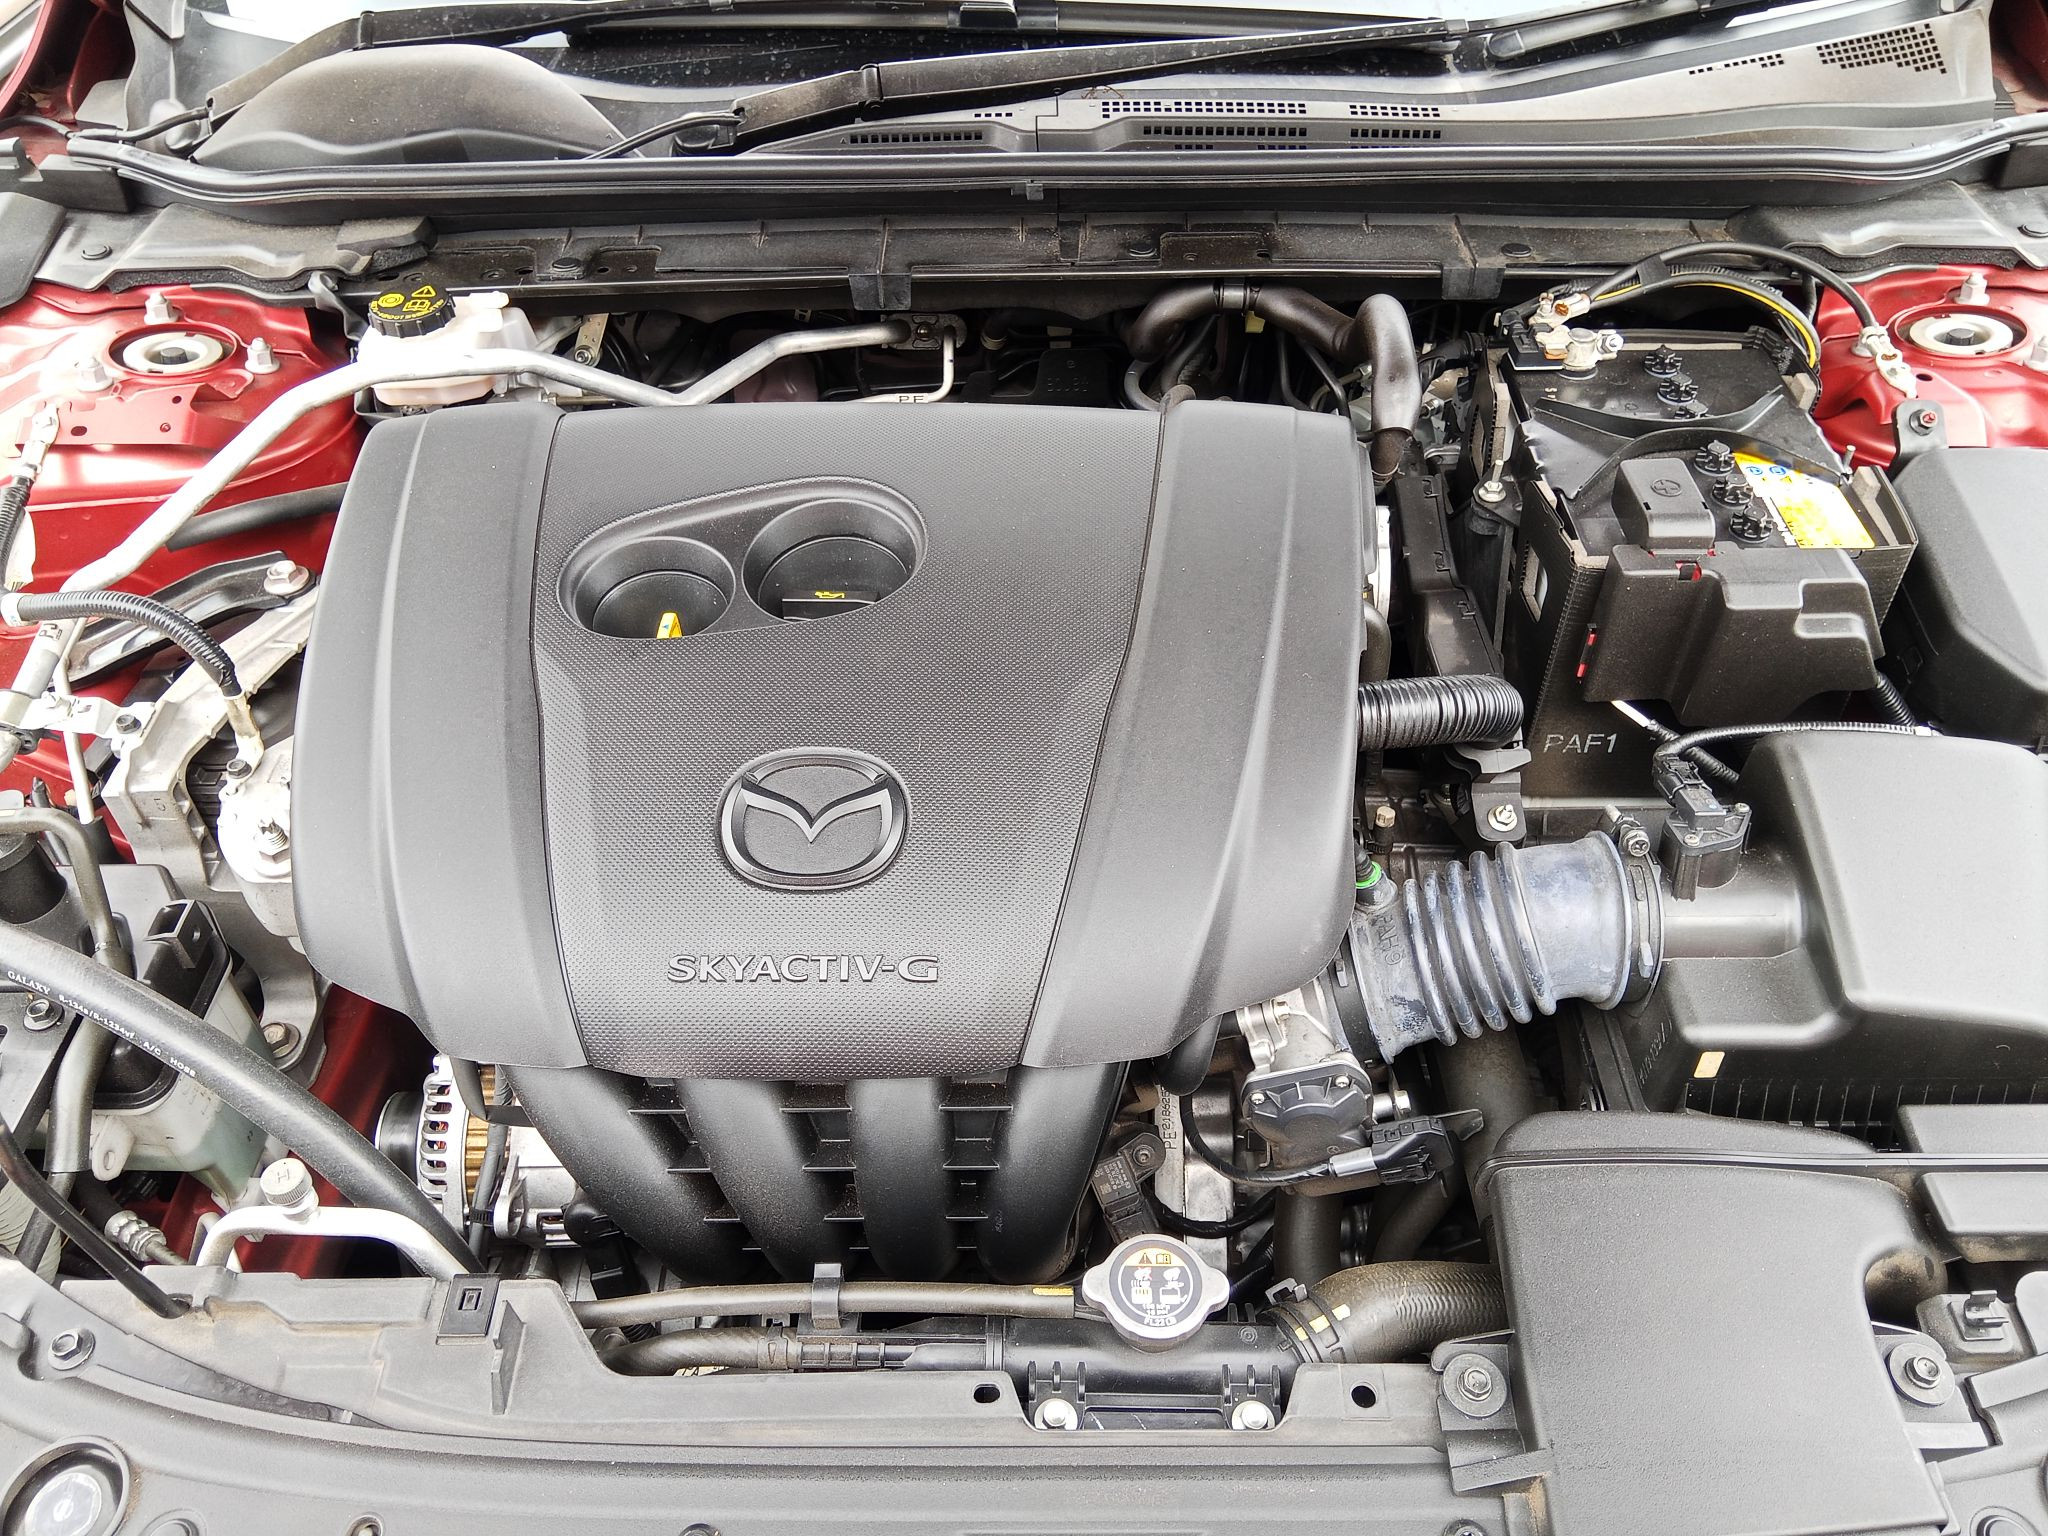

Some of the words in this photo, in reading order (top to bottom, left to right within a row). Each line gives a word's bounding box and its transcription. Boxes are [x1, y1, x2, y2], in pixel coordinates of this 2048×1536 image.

[1543, 733, 1617, 753] PAF1
[667, 954, 938, 983] SKYACTIV-G
[7, 970, 51, 995] GALAXY
[170, 1056, 196, 1078] HOSE
